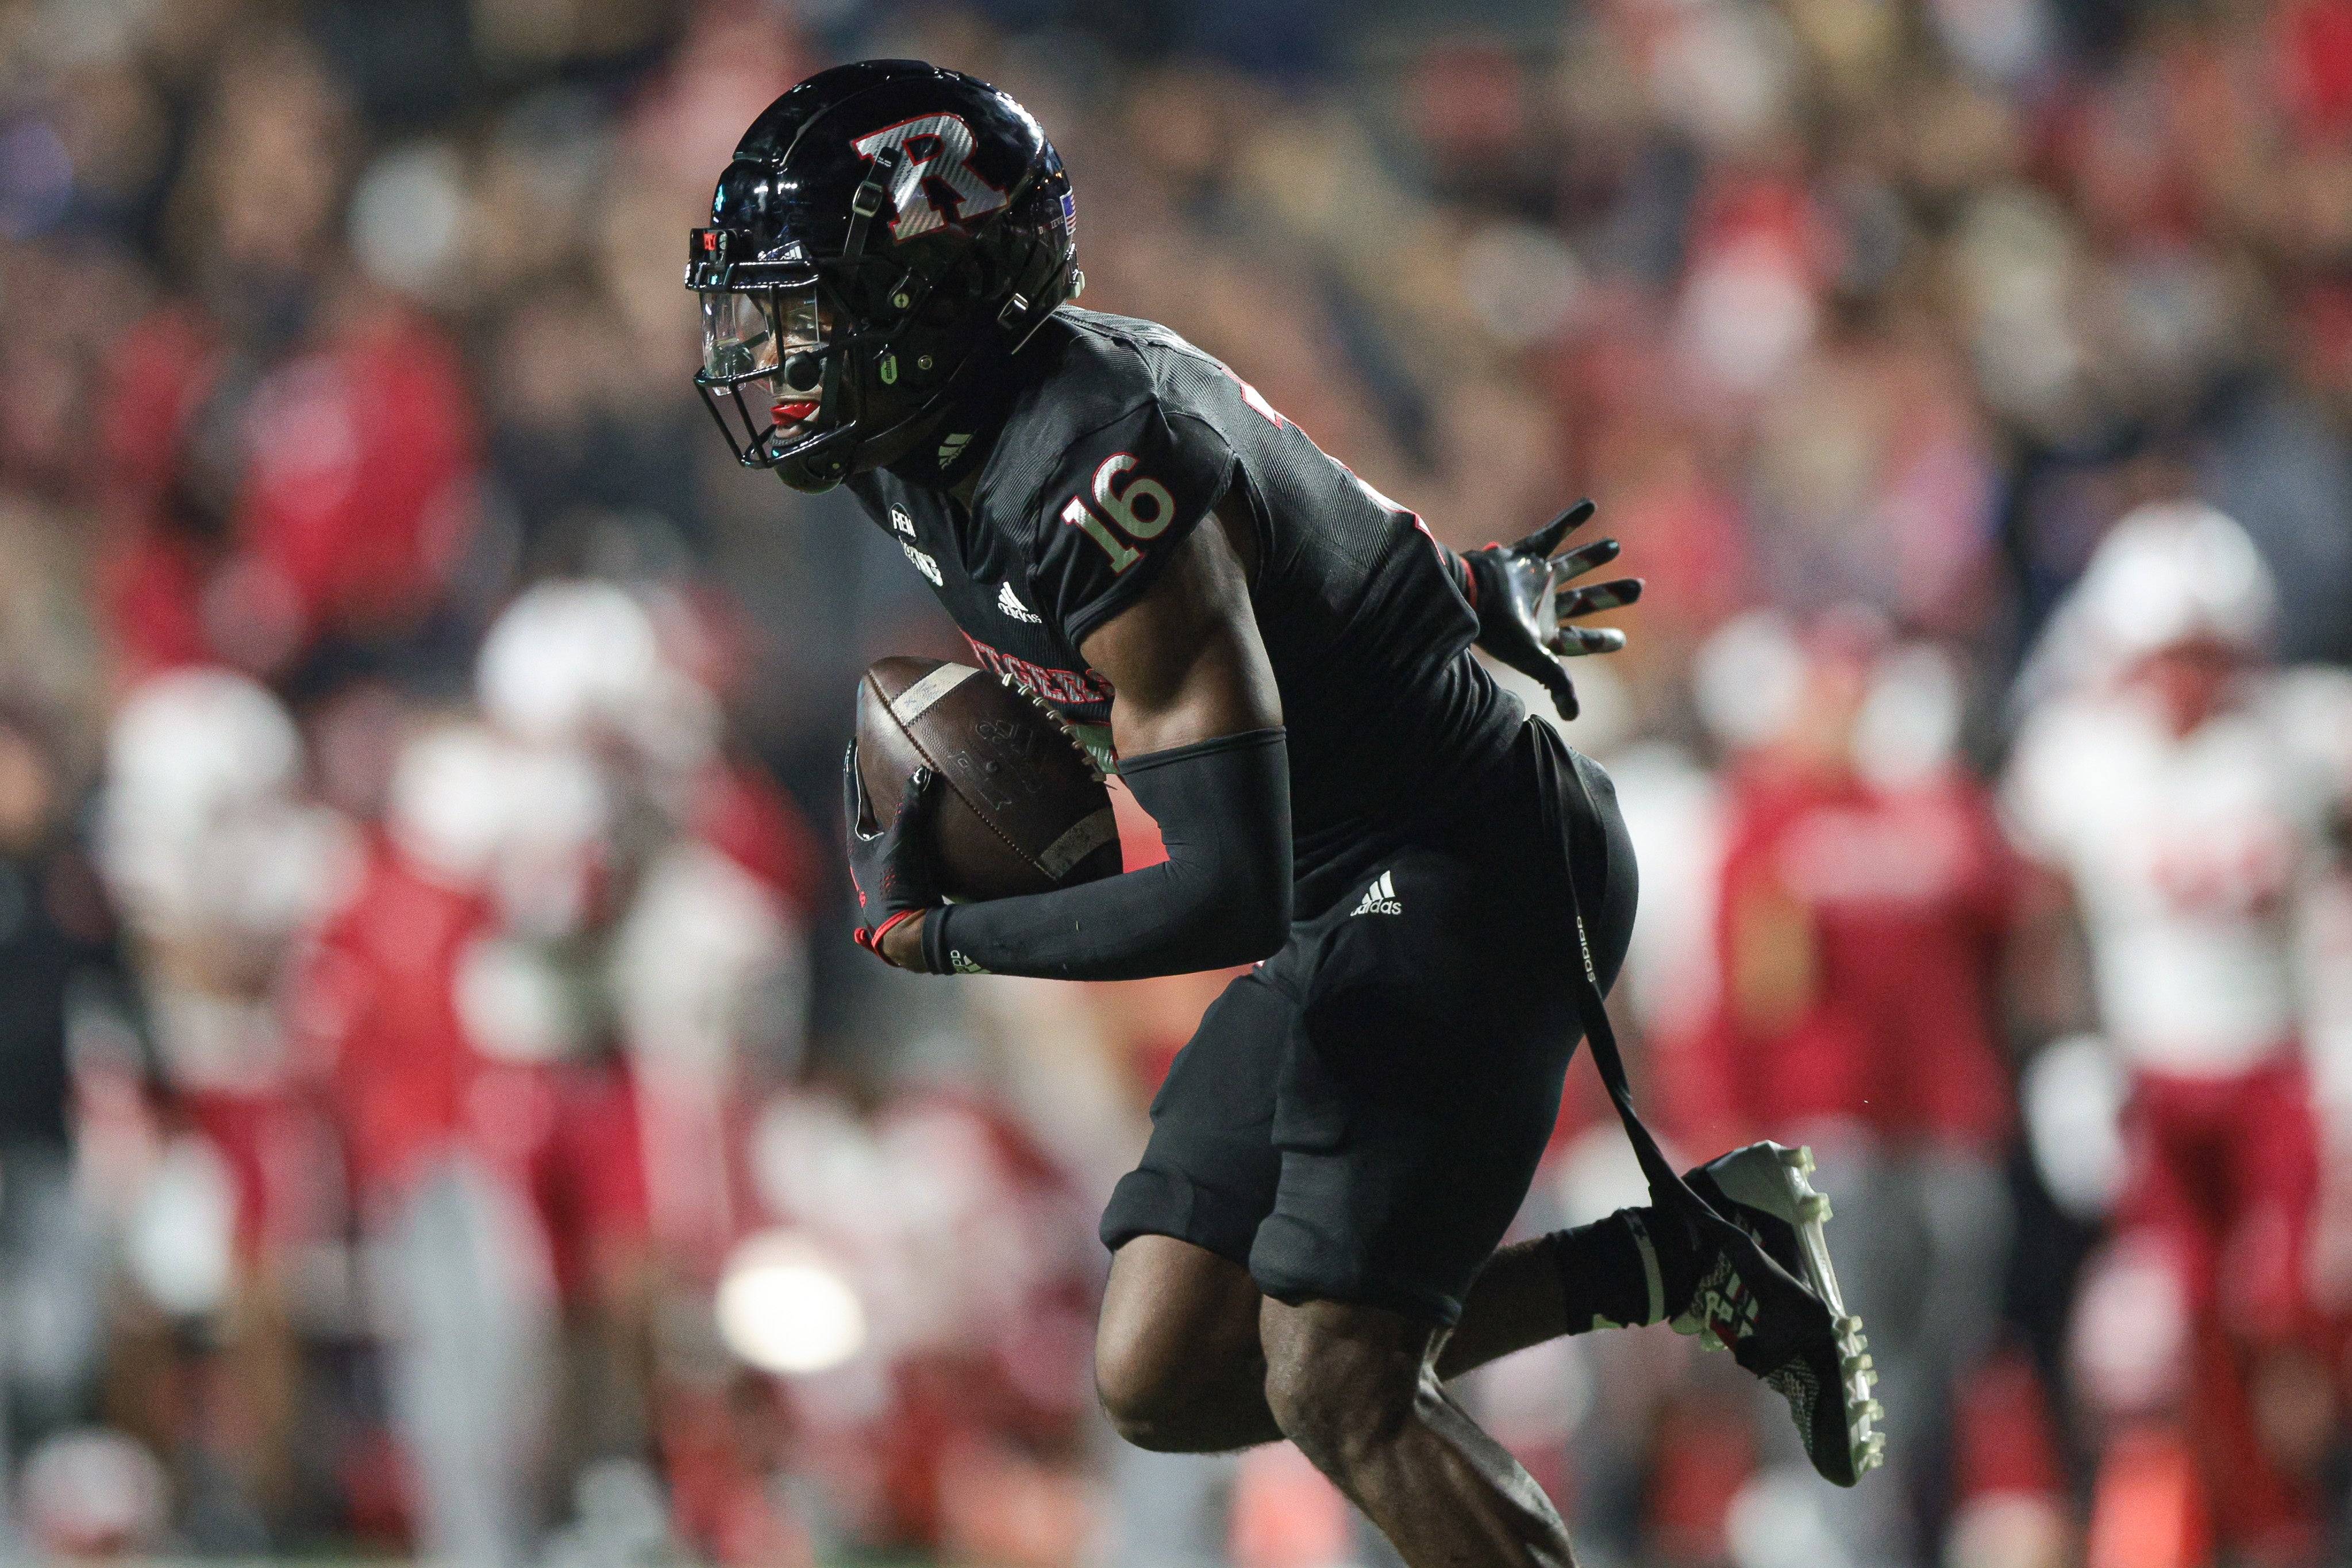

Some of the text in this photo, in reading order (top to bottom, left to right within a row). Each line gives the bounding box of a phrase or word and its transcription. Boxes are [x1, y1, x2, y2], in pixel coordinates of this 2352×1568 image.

[850, 112, 1010, 244] R
[1060, 452, 1176, 576] 16
[998, 602, 1042, 623] adidas
[1350, 897, 1402, 916] adidas
[1576, 915, 1596, 983] adidas
